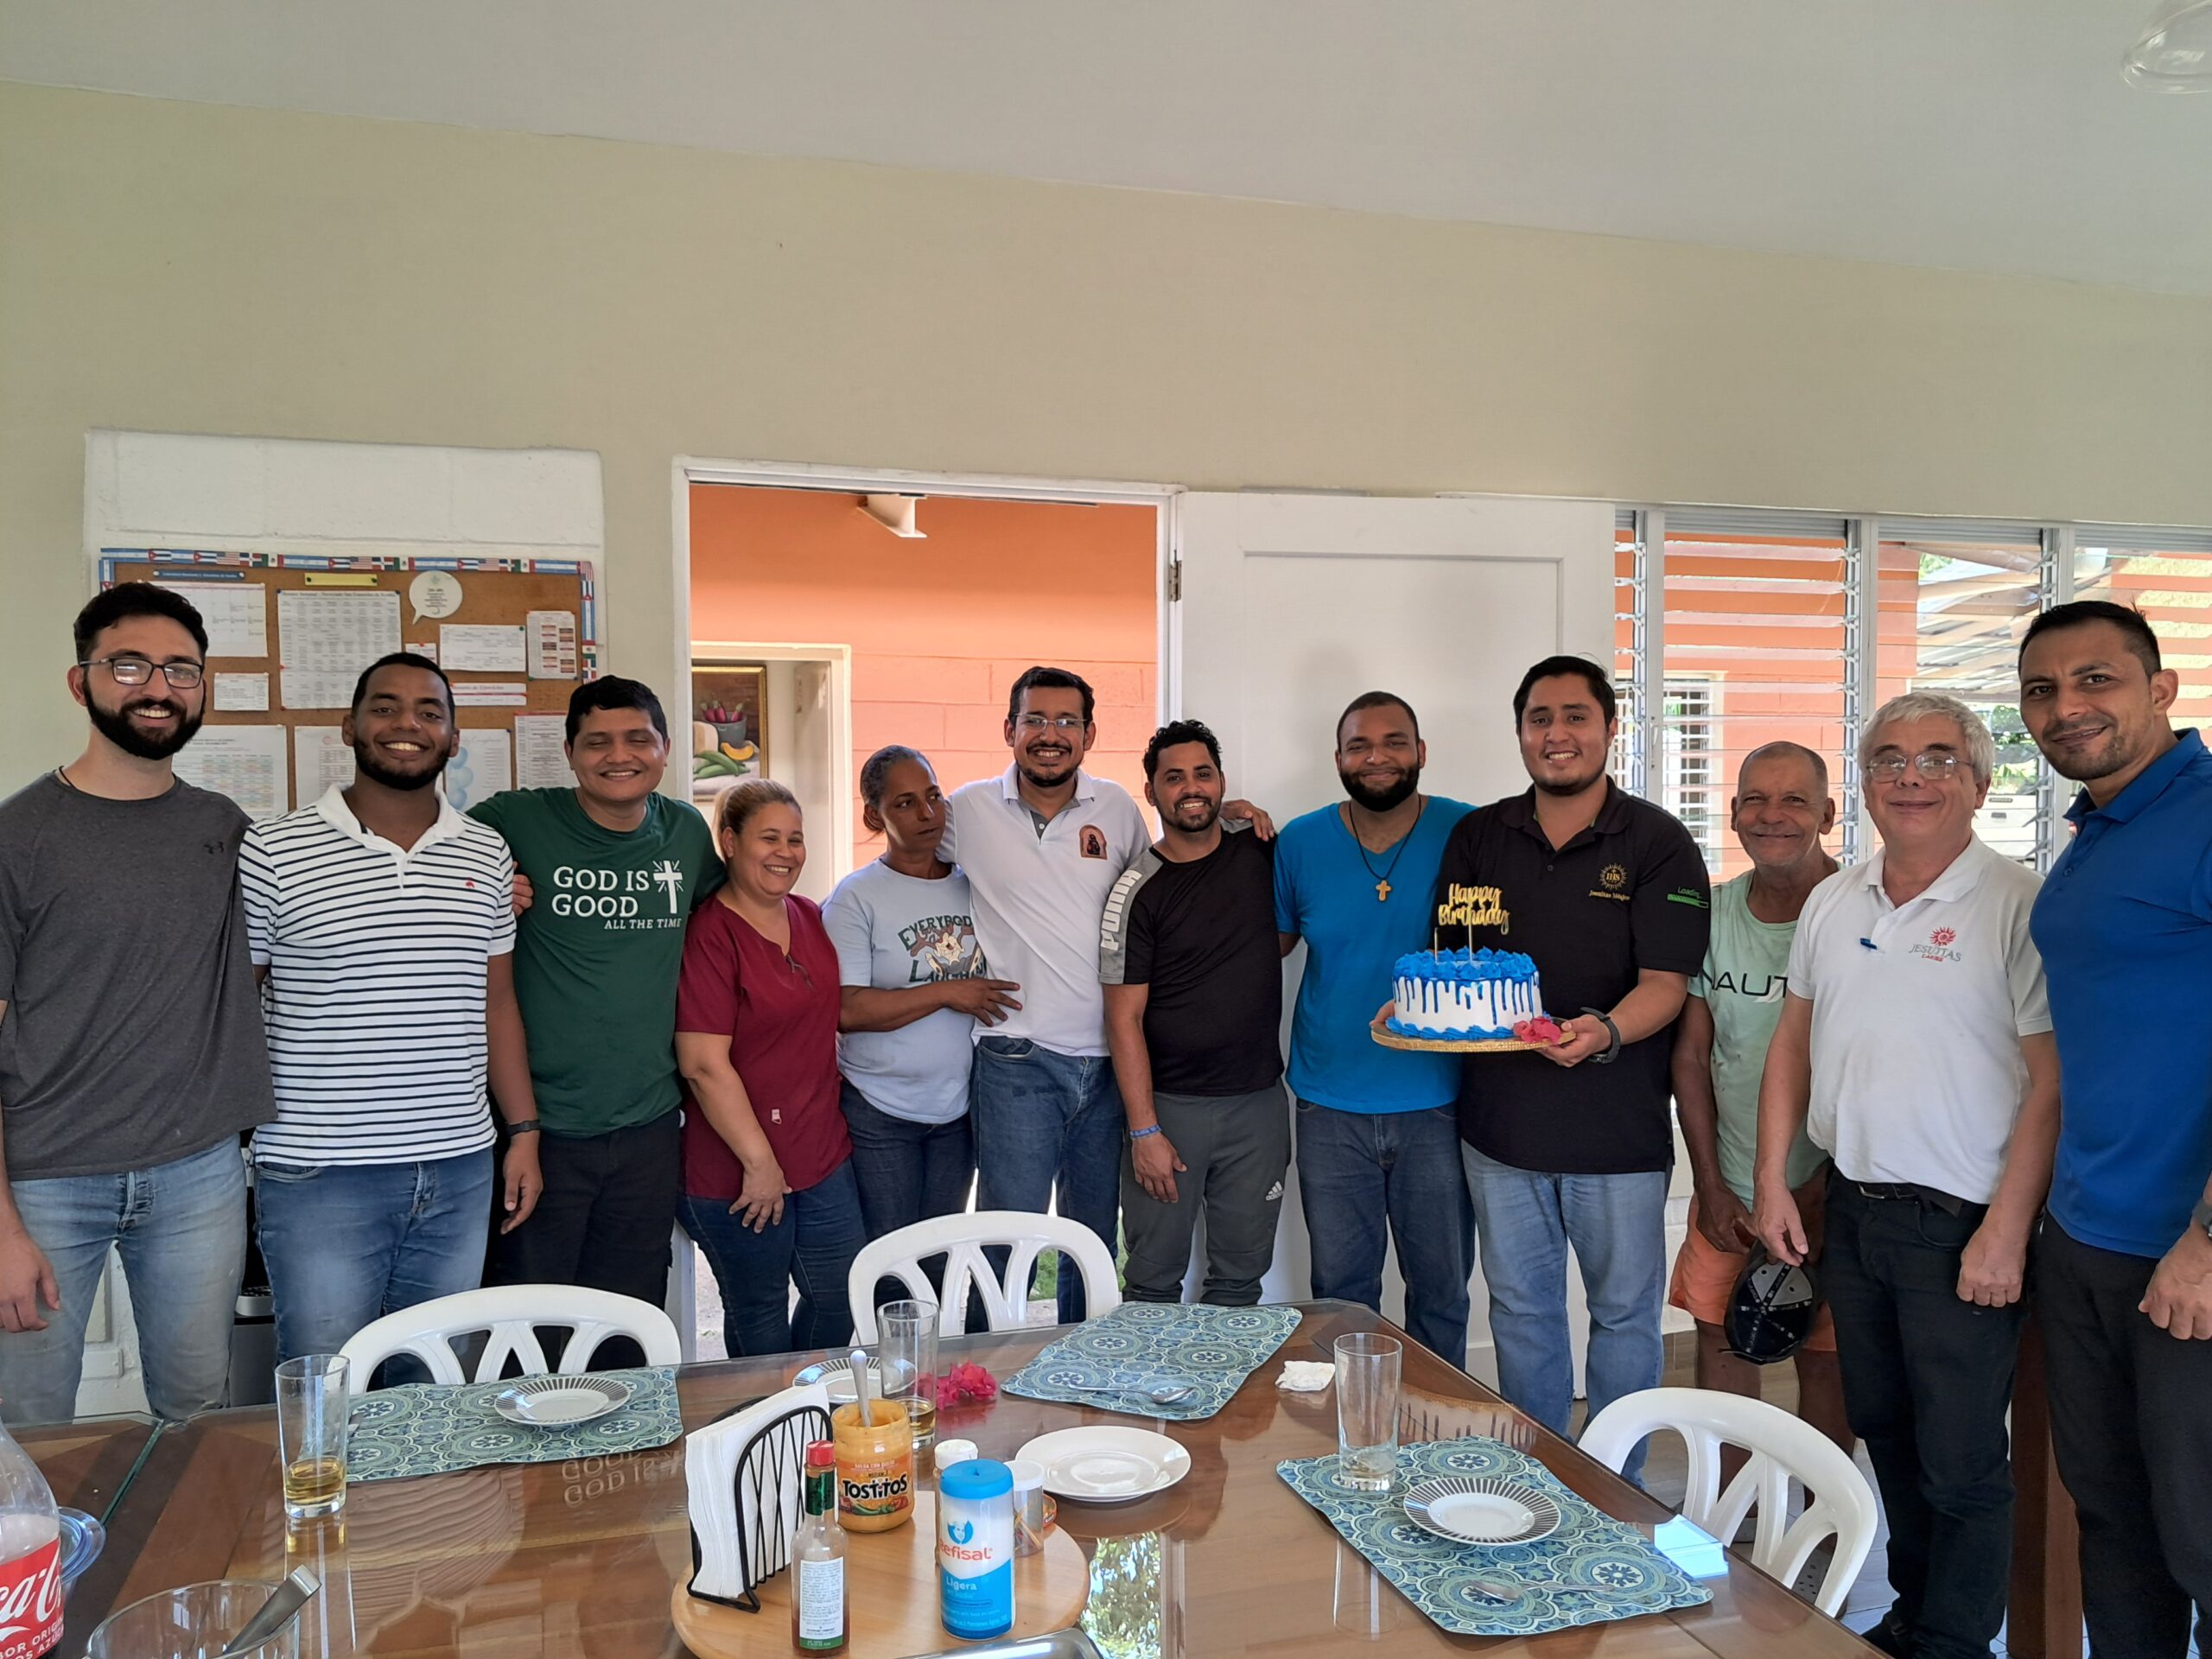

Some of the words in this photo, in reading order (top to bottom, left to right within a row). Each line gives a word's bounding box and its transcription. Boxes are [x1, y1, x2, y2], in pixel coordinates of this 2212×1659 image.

[553, 866, 618, 891] GOD
[625, 870, 650, 891] IS
[551, 893, 639, 918] GOOD
[1448, 883, 1503, 910] Happy
[1101, 869, 1142, 951] PUMA
[1438, 904, 1510, 936] Birthday
[604, 919, 626, 930] ALL
[629, 918, 653, 929] THE
[657, 918, 682, 929] TIME
[898, 915, 973, 951] EVERYBOD
[1908, 944, 1961, 962] JESUITAS
[1700, 968, 1789, 998] NAUT
[946, 1576, 977, 1591] Ligera
